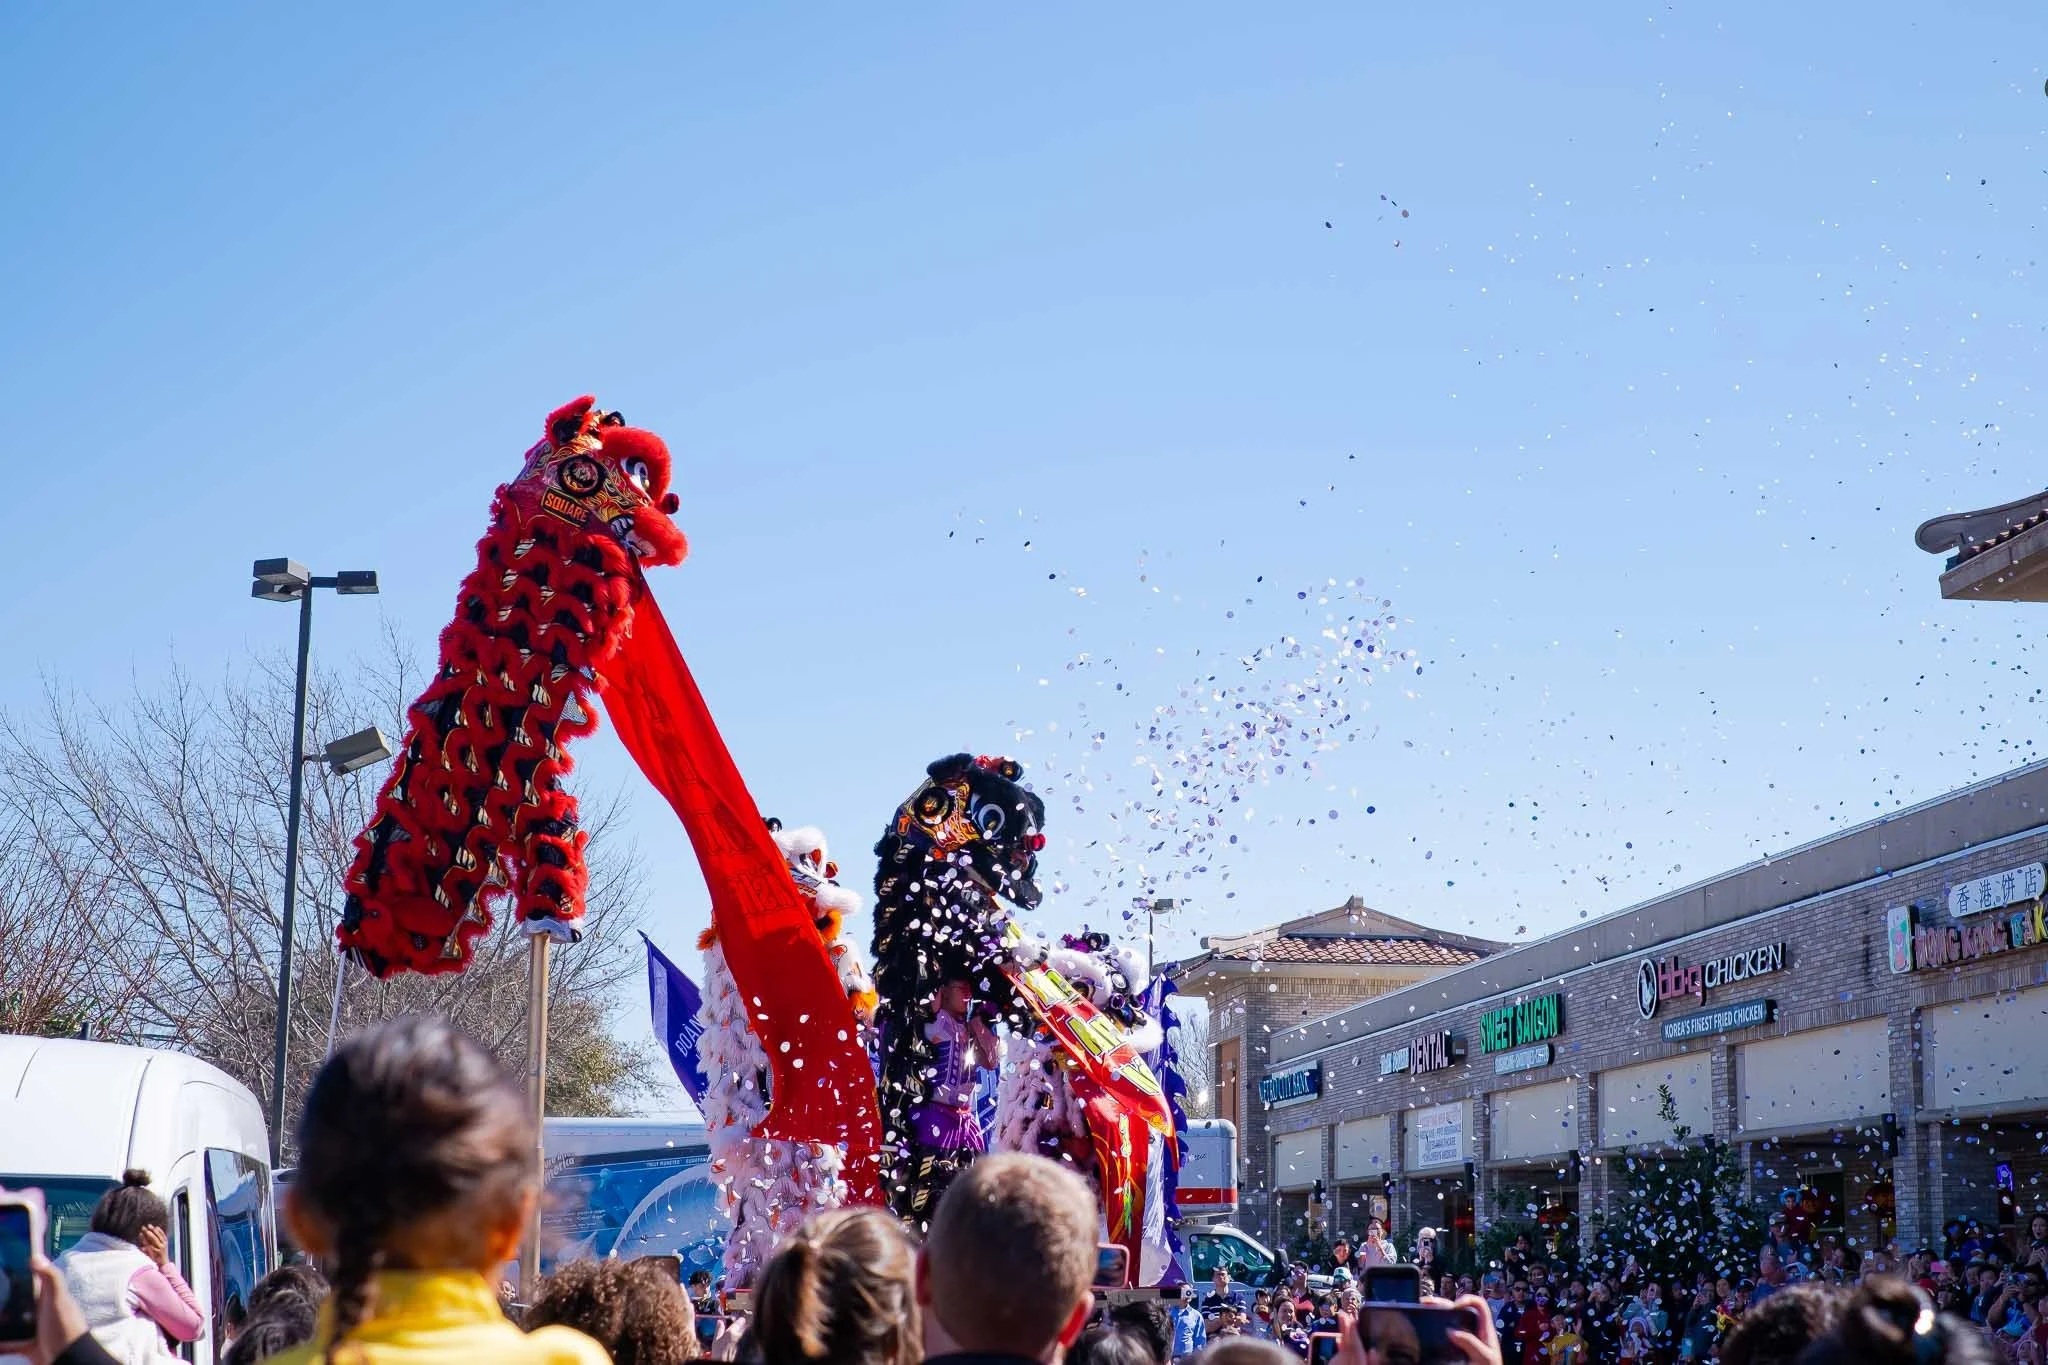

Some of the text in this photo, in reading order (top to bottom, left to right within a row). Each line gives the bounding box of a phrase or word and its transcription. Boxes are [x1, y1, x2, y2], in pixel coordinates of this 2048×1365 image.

[545, 492, 588, 523] SQUARE
[1915, 903, 2048, 970] HONG KONG BAK
[1705, 942, 1783, 988] CHICKEN
[1480, 991, 1558, 1056] SWEET SAIGON
[1664, 1003, 1764, 1038] KOREA'S FINEST FRIED CHICKEN
[1410, 1031, 1449, 1076] DENTAL
[1278, 1072, 1293, 1101] CITY
[1293, 1068, 1311, 1097] BANK
